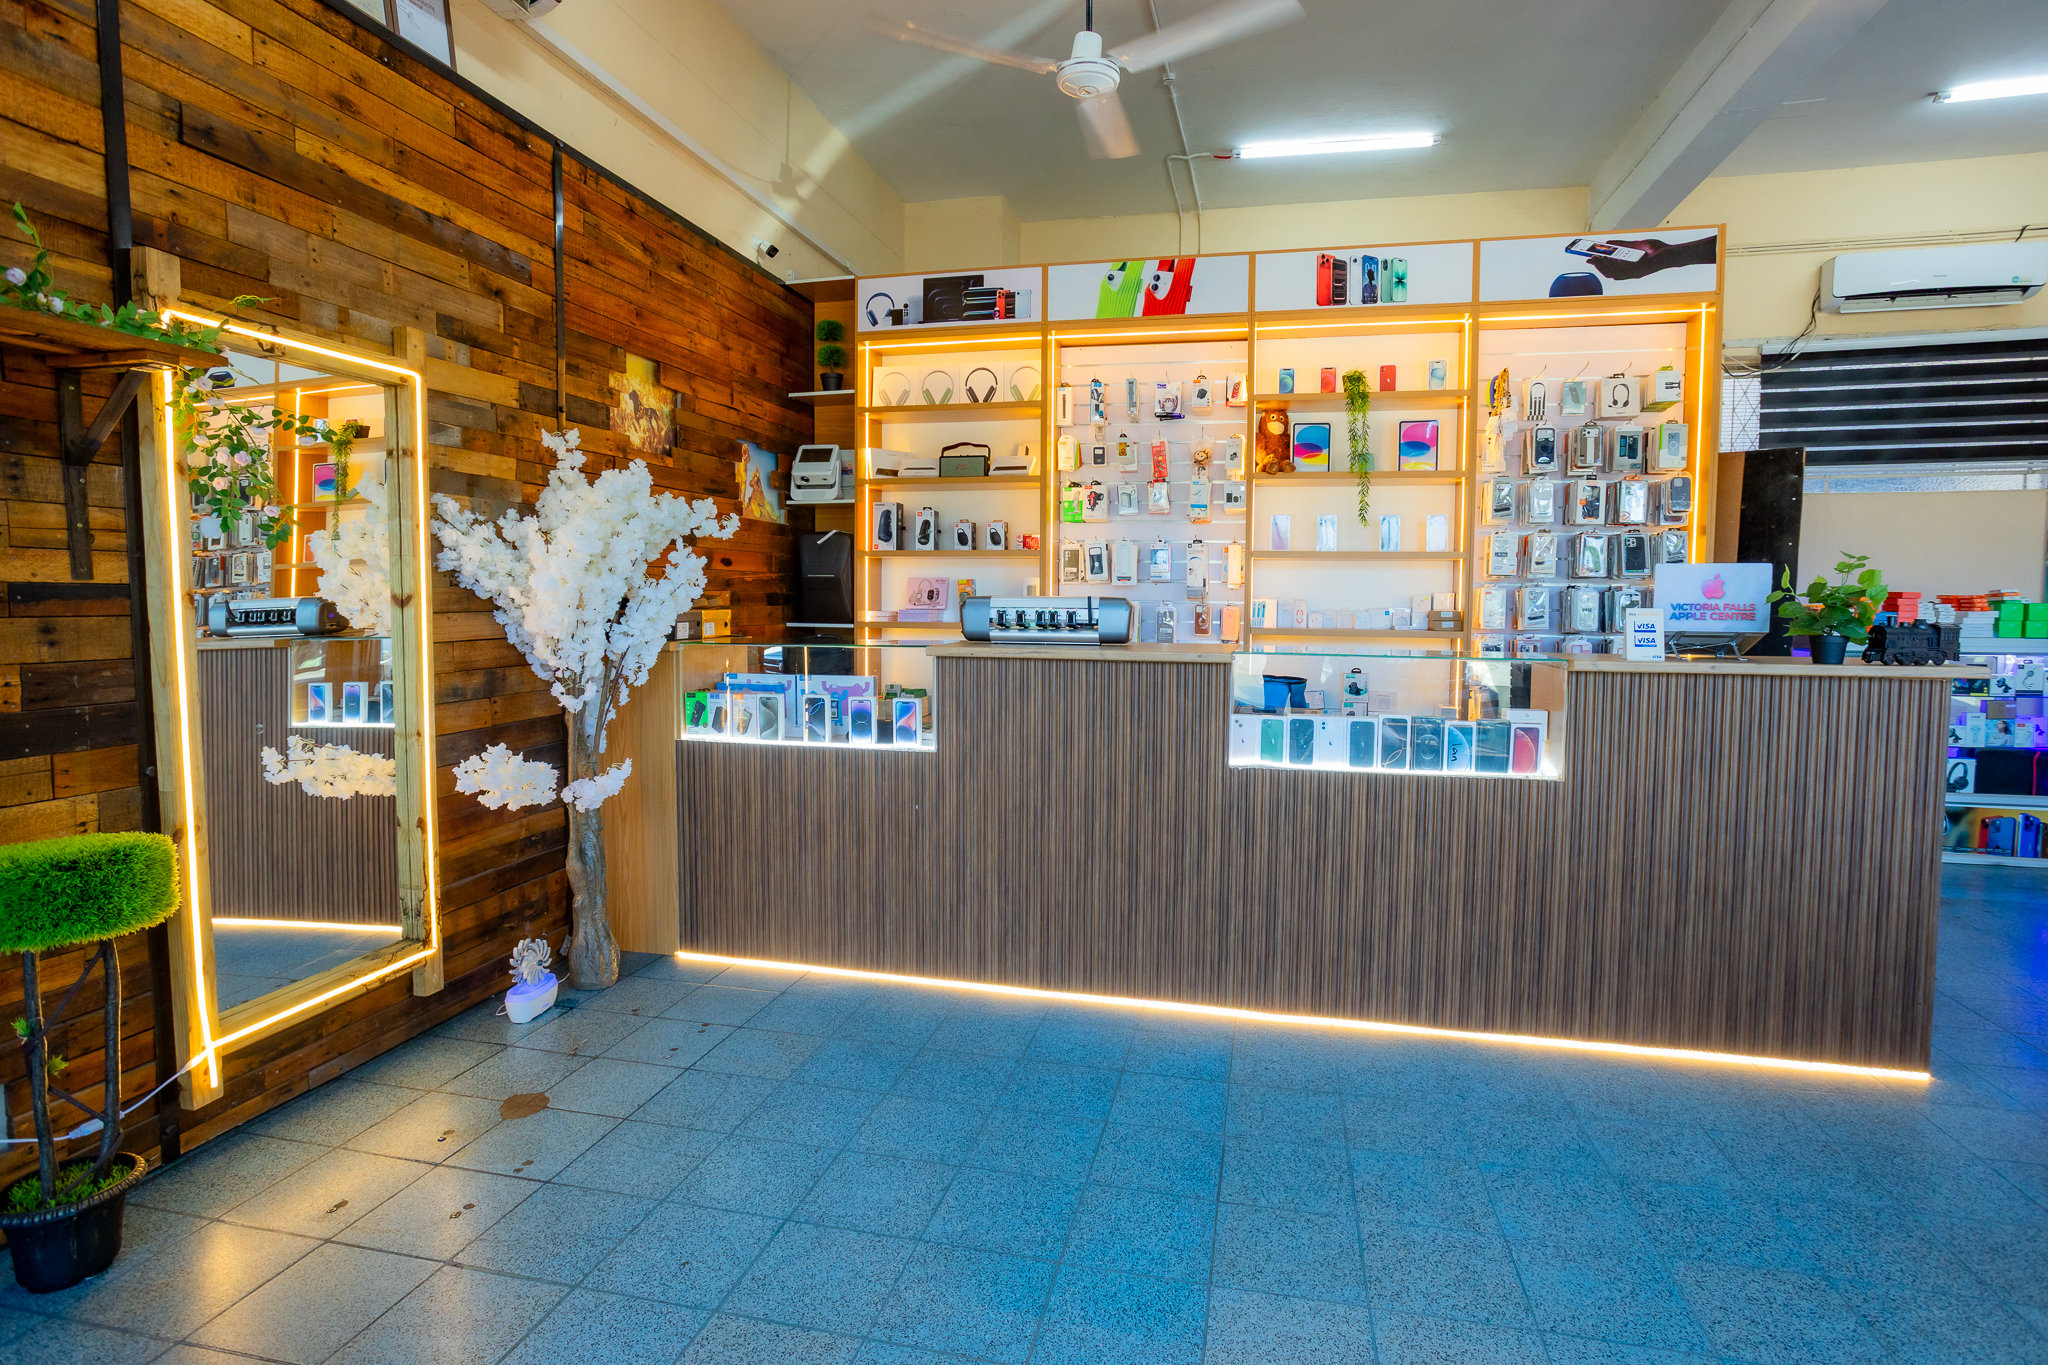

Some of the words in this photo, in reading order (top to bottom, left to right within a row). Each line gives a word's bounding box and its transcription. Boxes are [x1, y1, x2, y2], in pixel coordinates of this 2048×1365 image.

[1670, 603, 1720, 611] VICTORIA
[1723, 603, 1756, 611] FALLS
[1669, 612, 1707, 621] APPLE
[1709, 612, 1756, 621] CENTRE
